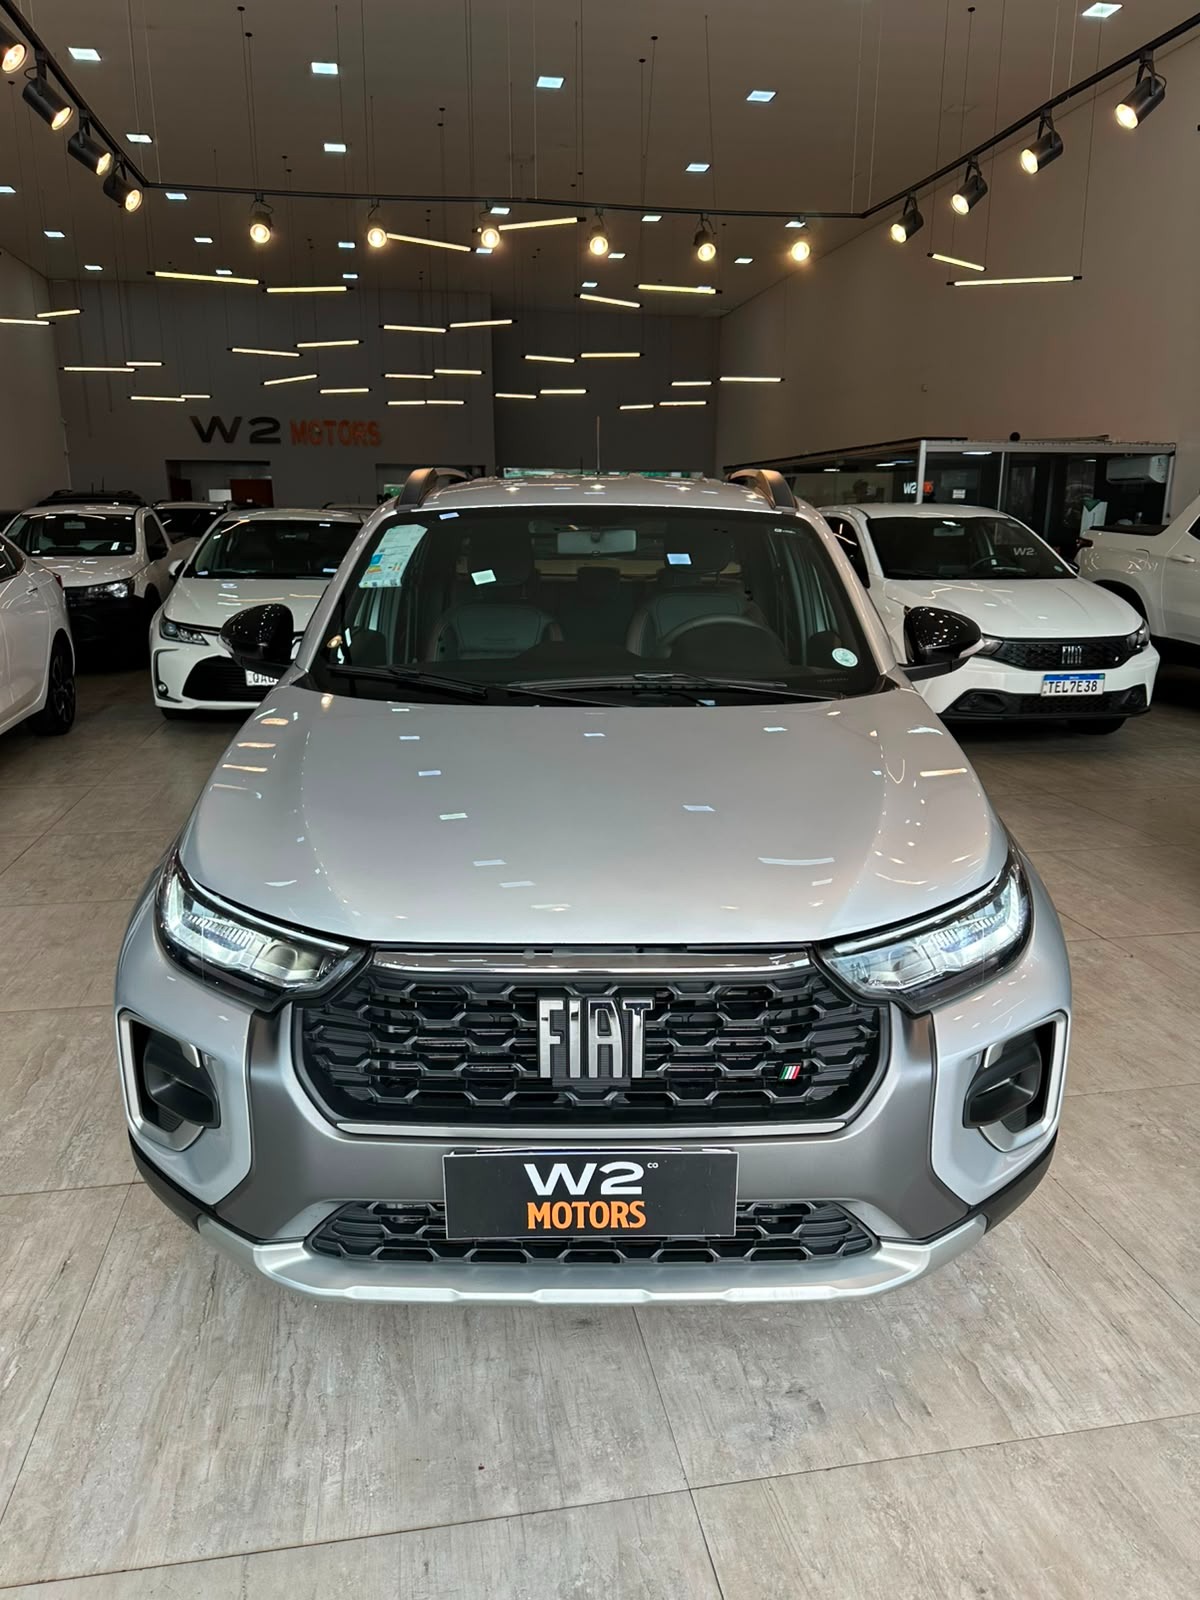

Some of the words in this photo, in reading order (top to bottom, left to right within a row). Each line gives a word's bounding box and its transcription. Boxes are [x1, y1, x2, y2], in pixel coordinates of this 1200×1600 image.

[190, 416, 281, 444] W2
[289, 419, 382, 447] MOTORS
[1013, 547, 1035, 556] W2
[1048, 681, 1098, 694] TEL7E38
[537, 998, 655, 1079] FIAT
[524, 1161, 645, 1196] W2
[527, 1200, 647, 1229] MOTORS
